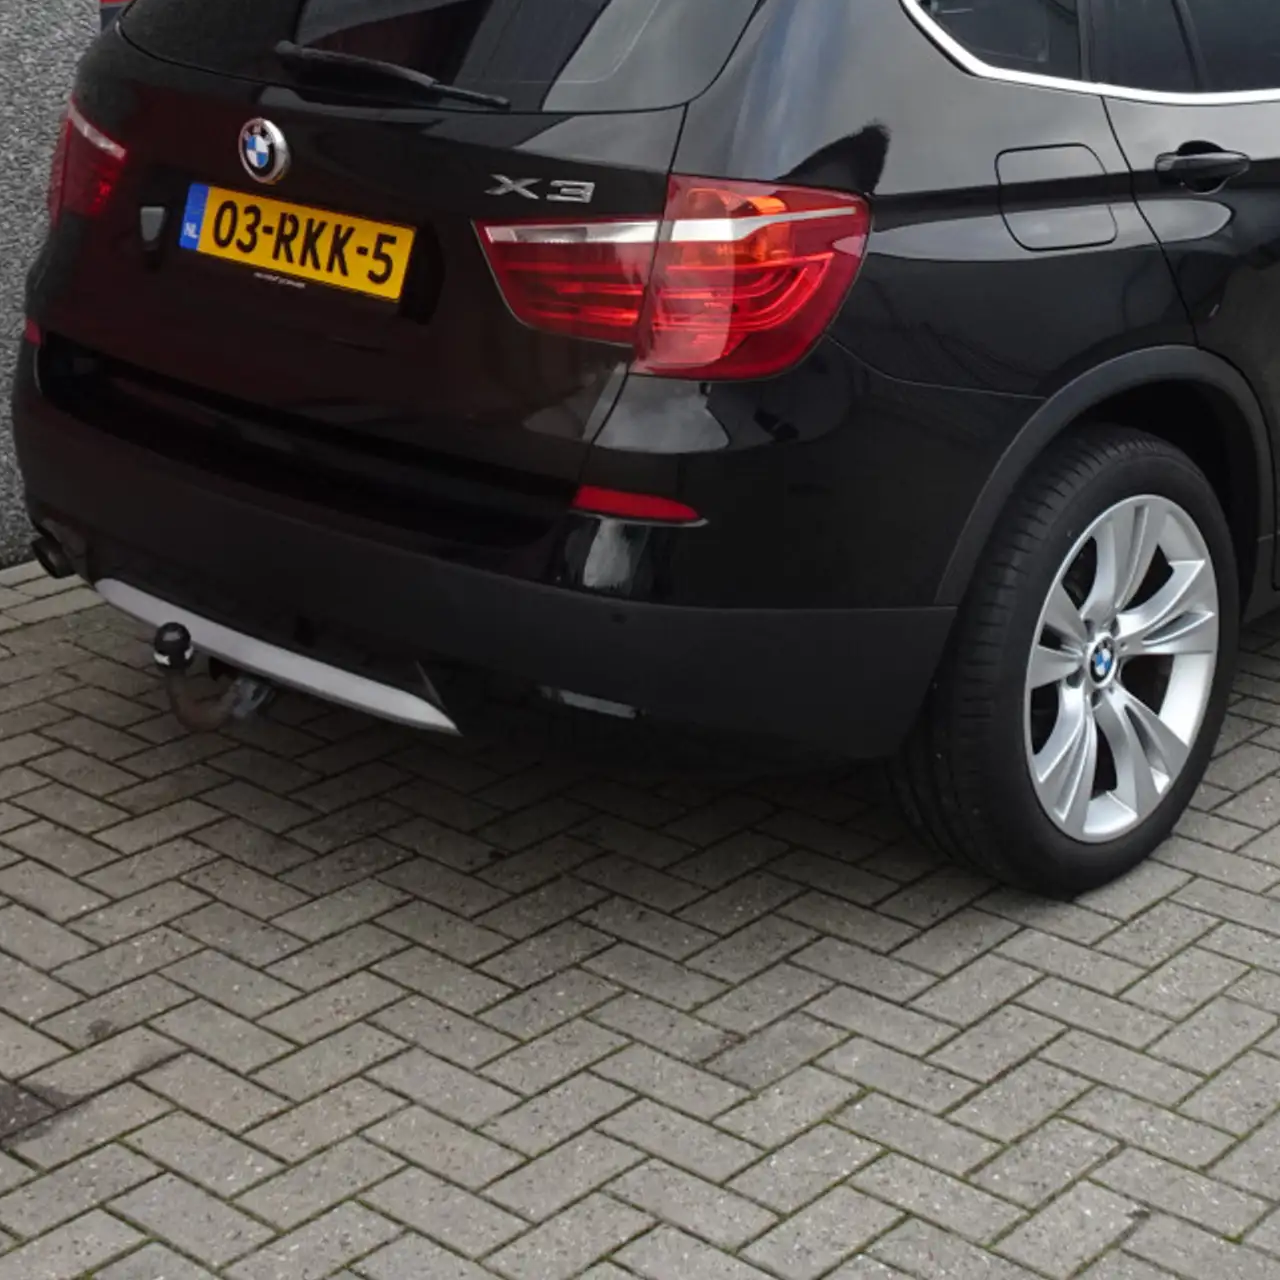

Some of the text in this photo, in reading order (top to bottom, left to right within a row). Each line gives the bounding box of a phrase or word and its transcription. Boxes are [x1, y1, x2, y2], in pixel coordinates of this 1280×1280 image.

[484, 173, 596, 204] X3
[183, 222, 198, 239] NL
[213, 199, 398, 285] 03-RKK-5
